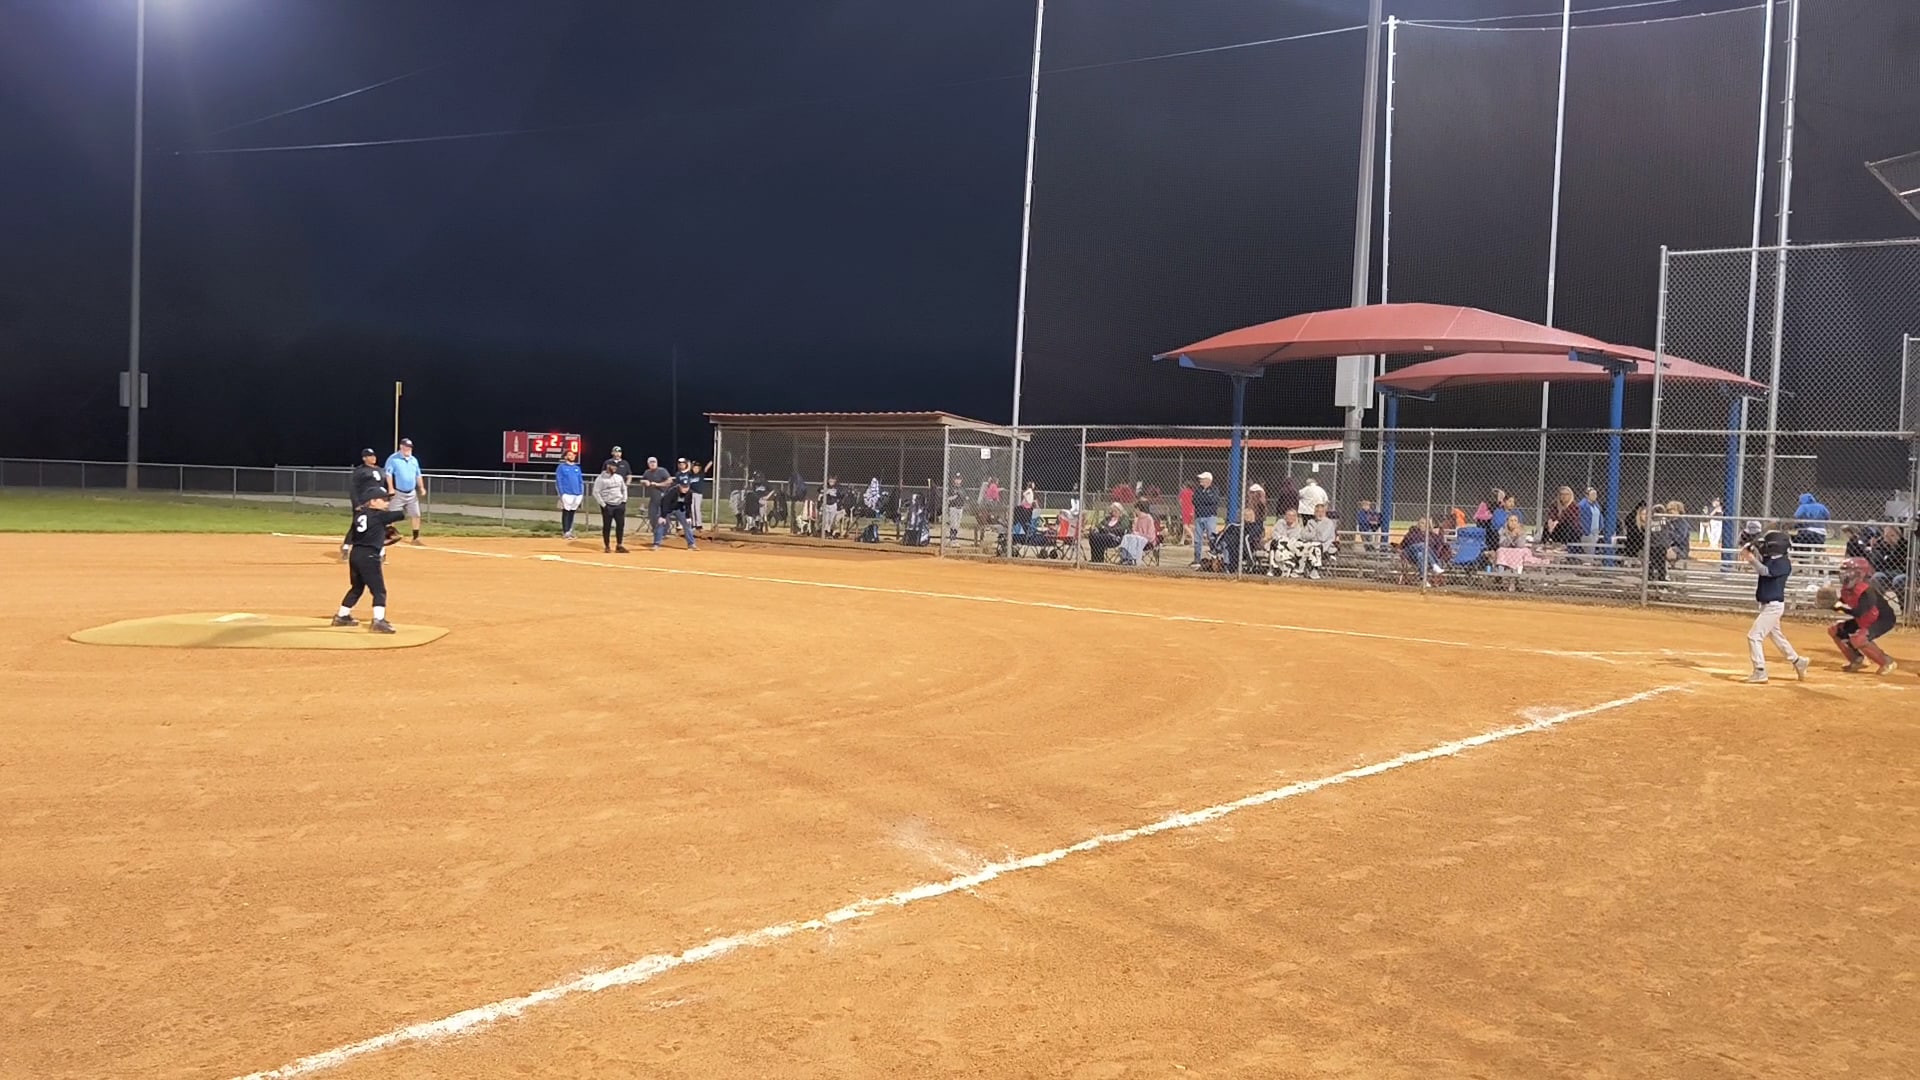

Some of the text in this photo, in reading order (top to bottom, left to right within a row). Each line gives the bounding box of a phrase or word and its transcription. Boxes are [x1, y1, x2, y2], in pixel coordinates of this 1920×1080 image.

[535, 440, 543, 452] 2
[550, 435, 558, 447] 2
[571, 441, 579, 453] 0
[356, 514, 368, 533] 3
